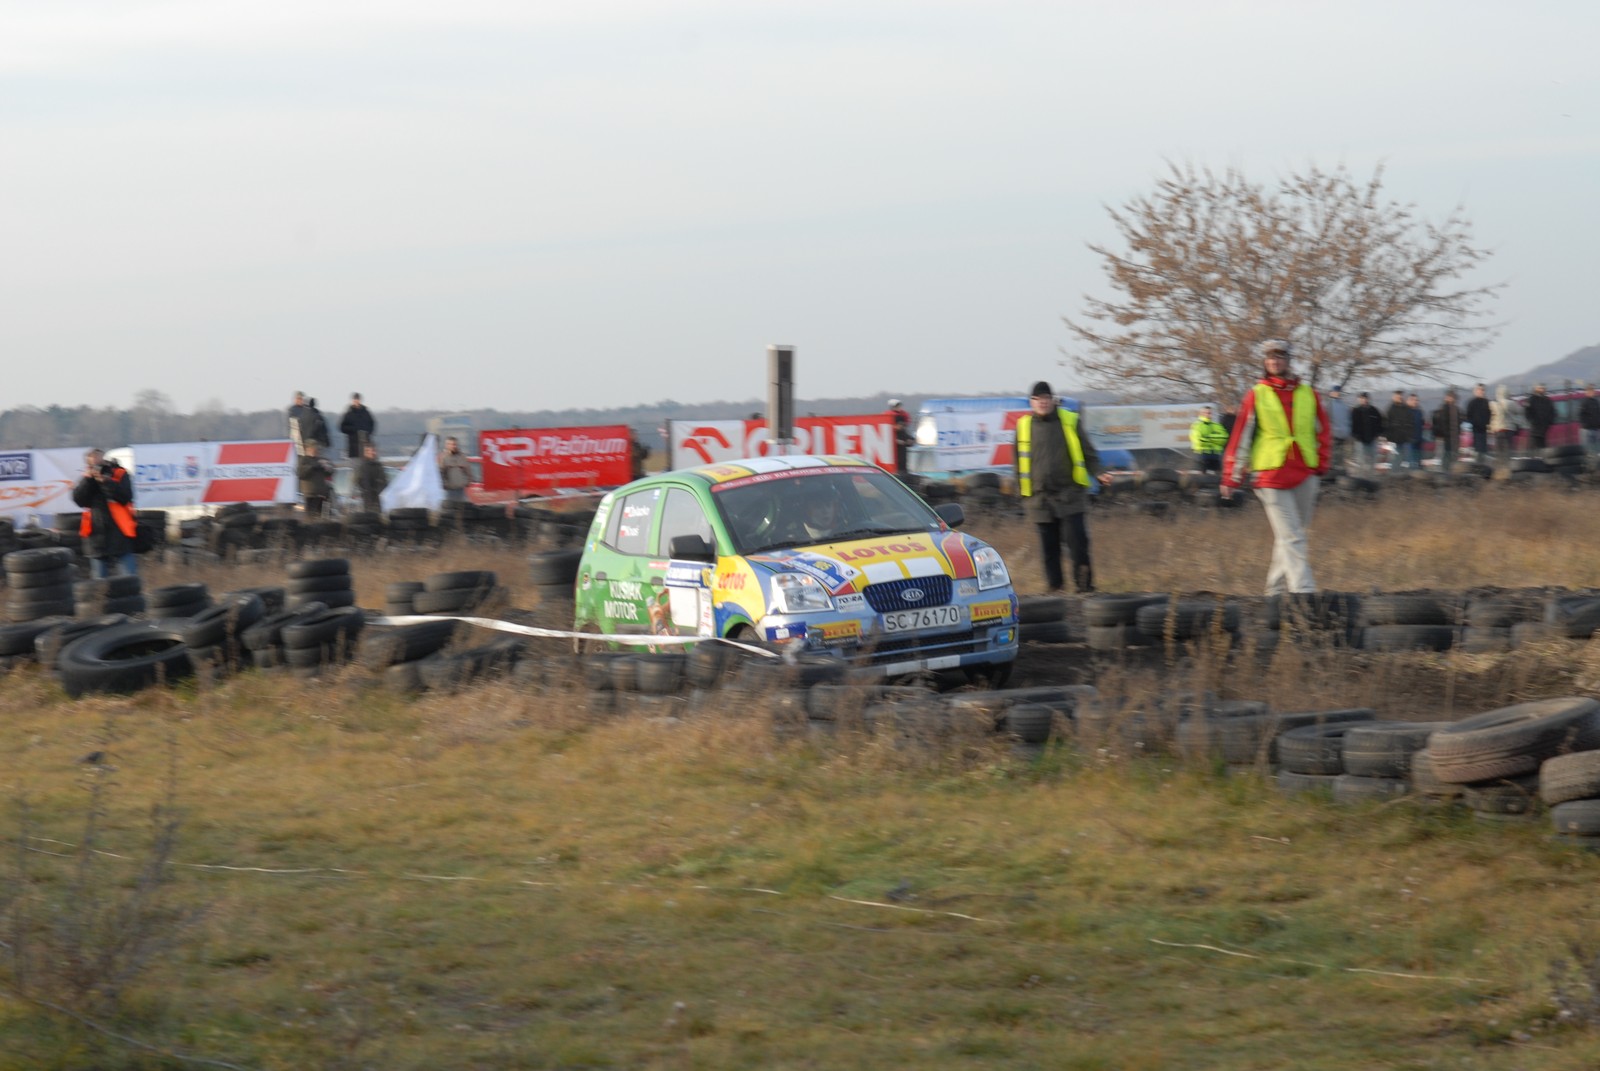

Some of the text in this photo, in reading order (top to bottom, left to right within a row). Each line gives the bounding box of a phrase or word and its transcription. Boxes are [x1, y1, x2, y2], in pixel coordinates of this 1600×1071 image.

[538, 435, 627, 456] Platinum
[748, 423, 895, 464] ORLEN
[837, 542, 927, 562] LOTOS
[718, 572, 747, 590] LOTOS
[904, 588, 922, 600] KIA
[604, 601, 638, 620] MOTOR
[885, 613, 908, 631] SC
[911, 606, 959, 629] 76170
[973, 603, 1010, 618] PIRELLI
